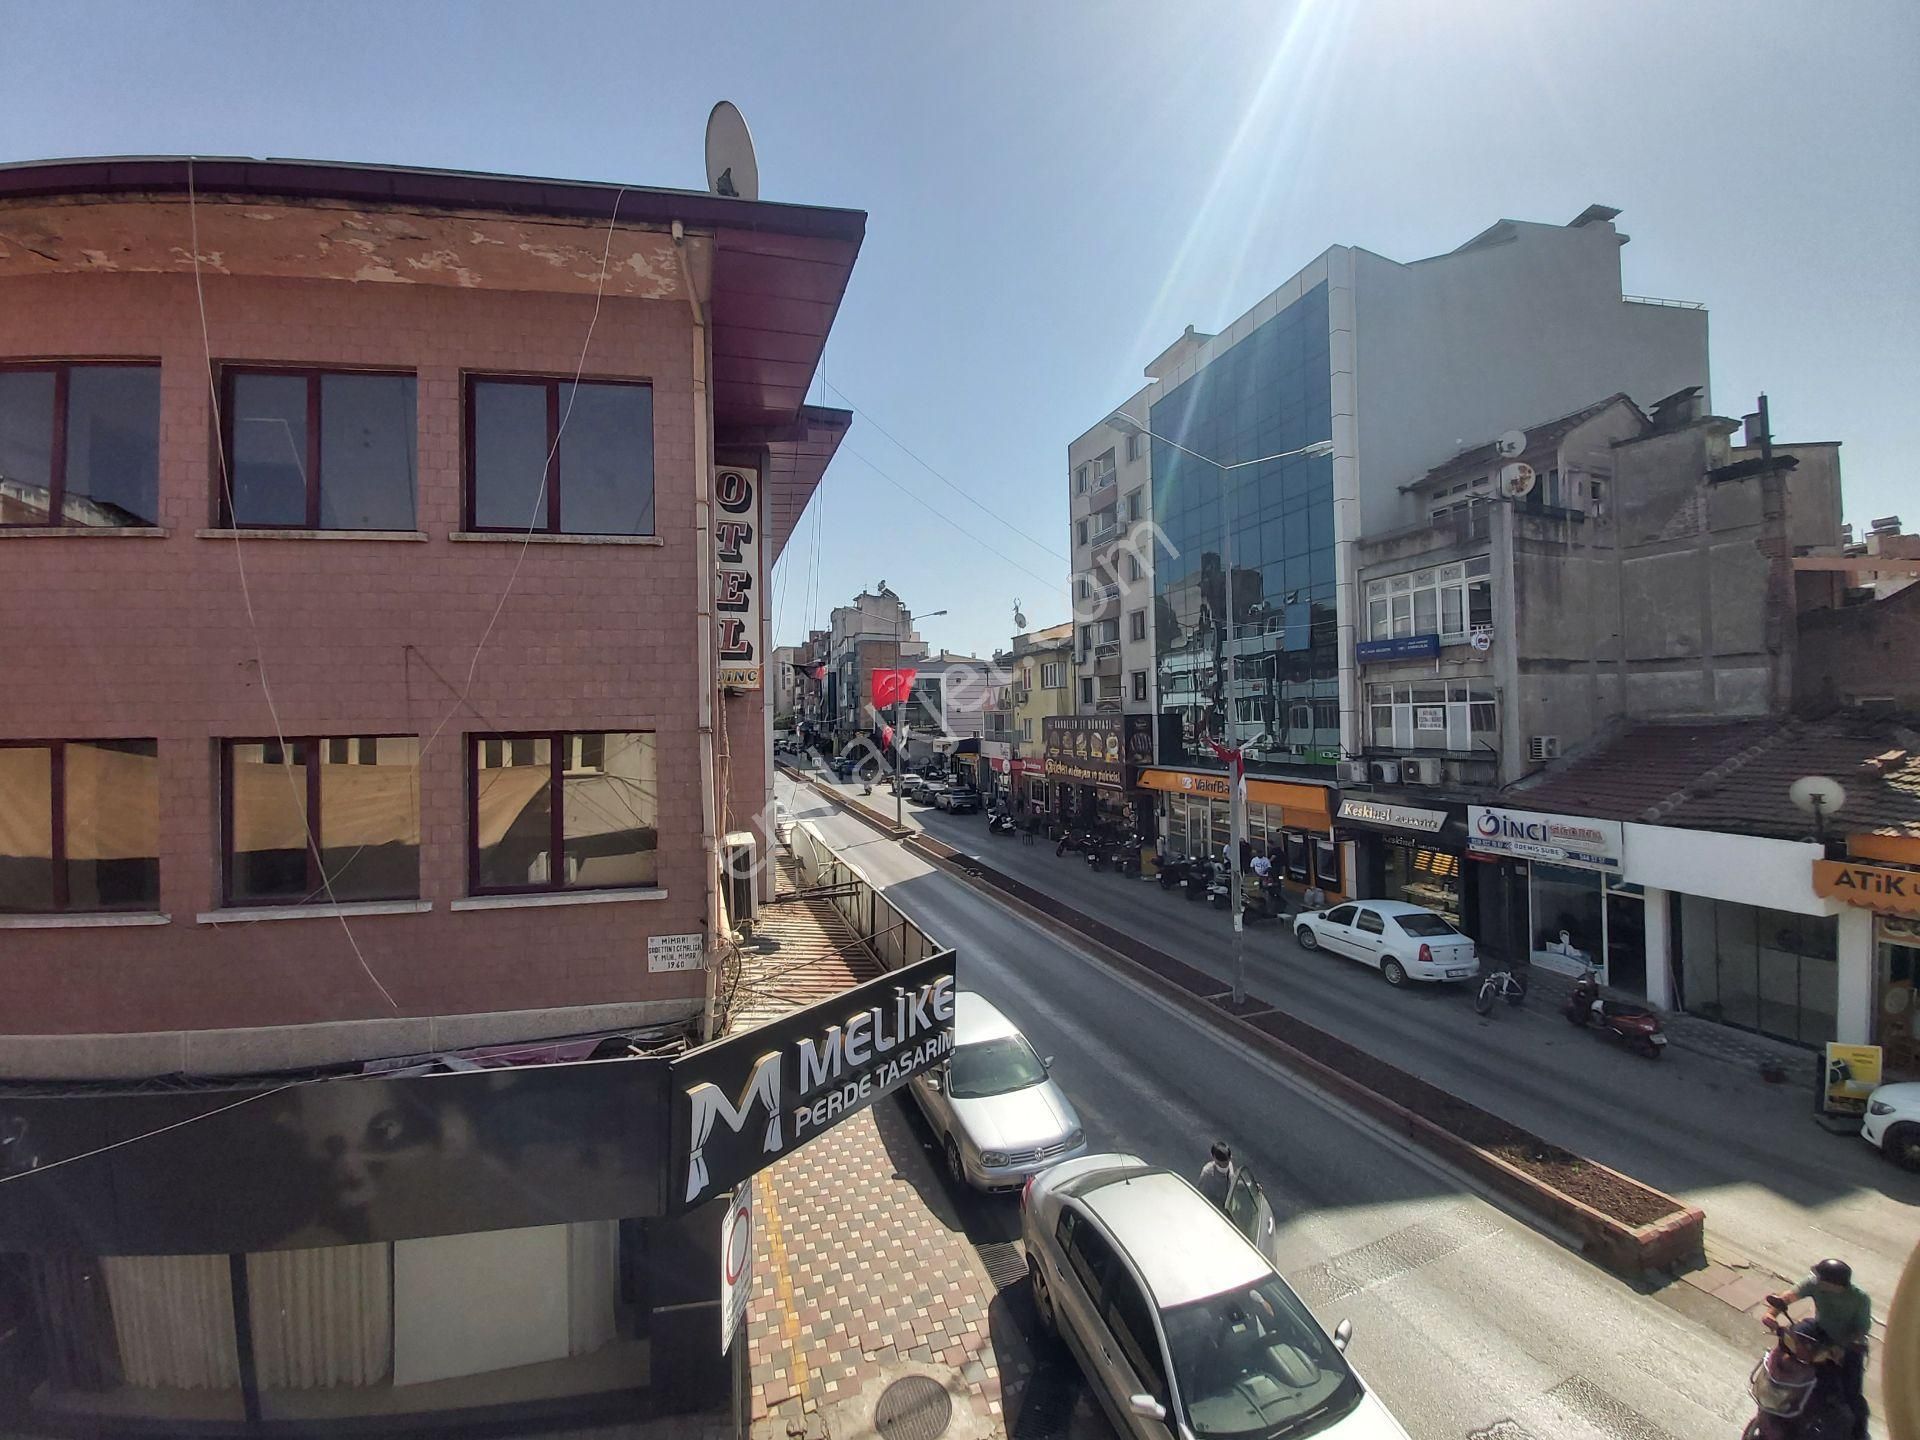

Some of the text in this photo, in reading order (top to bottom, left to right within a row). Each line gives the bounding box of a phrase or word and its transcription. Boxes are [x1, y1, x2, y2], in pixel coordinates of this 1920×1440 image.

[716, 471, 752, 661] OTEL
[1195, 778, 1230, 794] VakıfBa
[1344, 803, 1391, 821] Keskinel
[667, 961, 685, 969] 1960
[797, 975, 954, 1096] MELİKE
[794, 1027, 956, 1138] PERDE TASARIM
